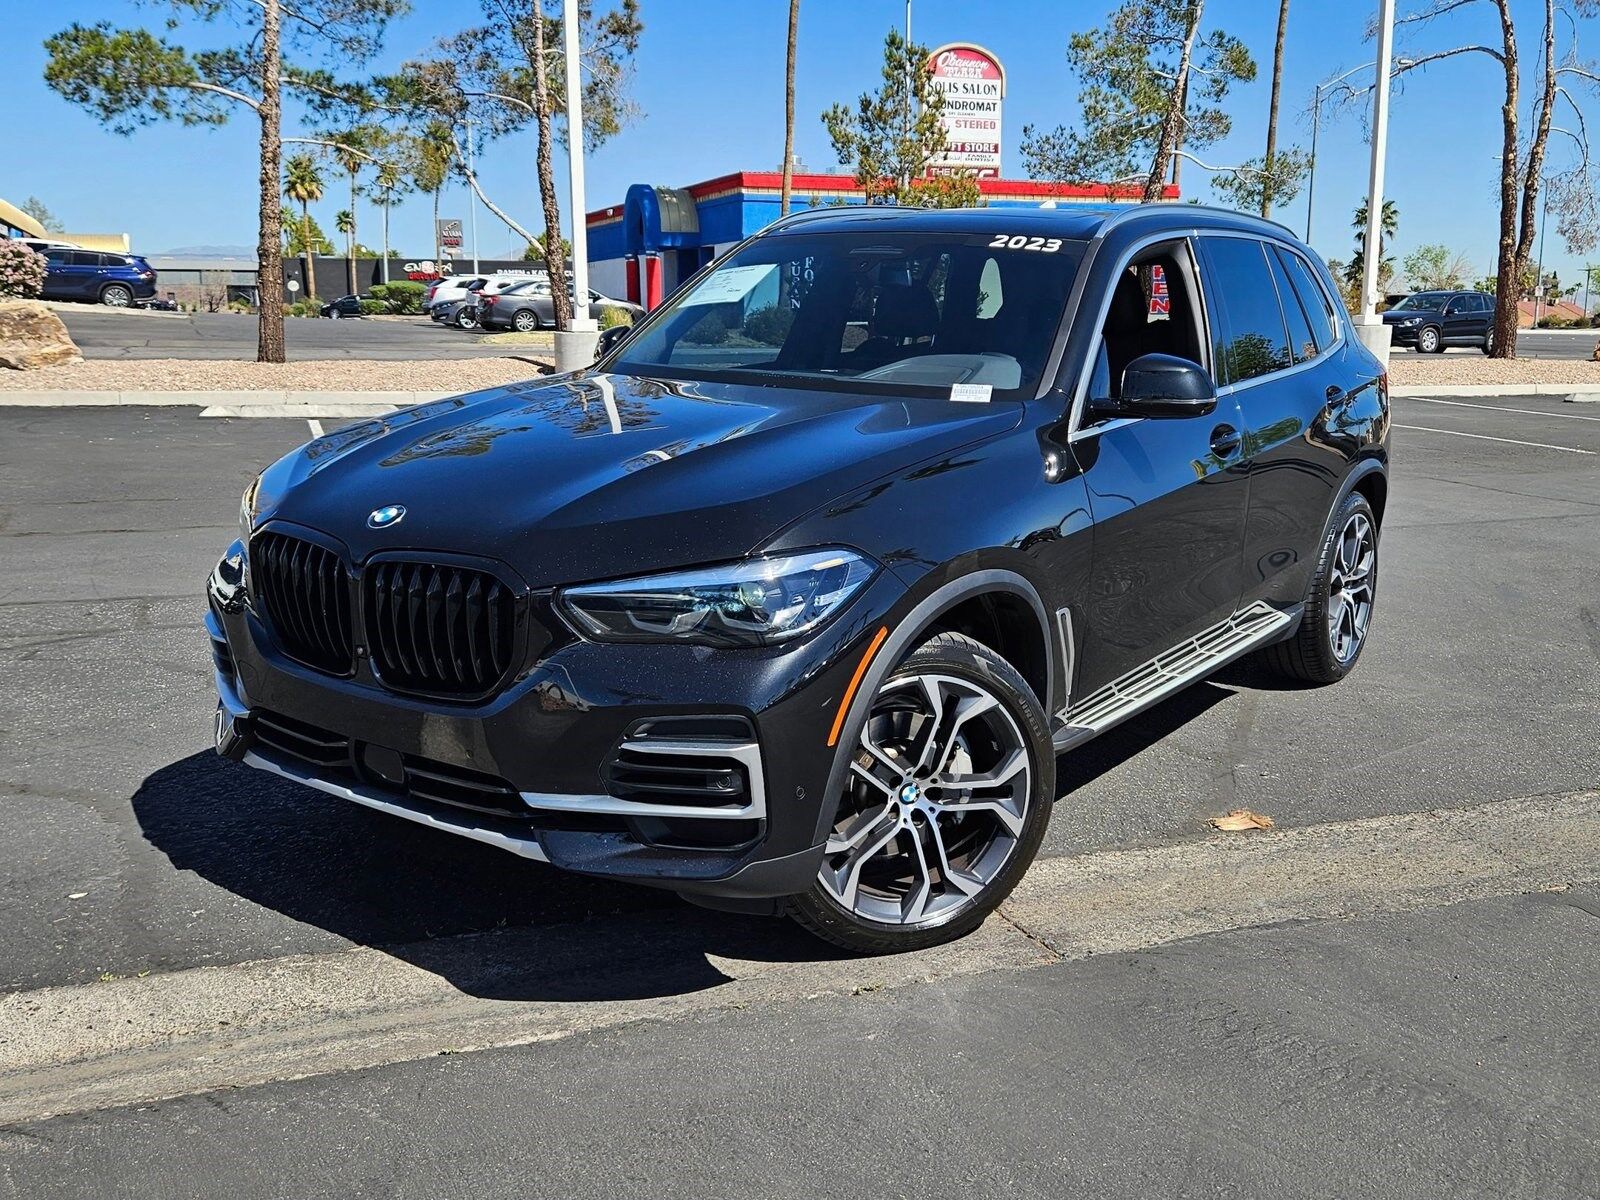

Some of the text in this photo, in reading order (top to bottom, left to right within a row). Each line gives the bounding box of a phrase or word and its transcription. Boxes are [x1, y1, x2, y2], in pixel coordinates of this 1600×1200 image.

[943, 67, 983, 78] PLAZA
[962, 82, 997, 95] SALON
[955, 119, 996, 130] STEREO
[965, 142, 996, 153] STORE
[988, 234, 1063, 253] 2023
